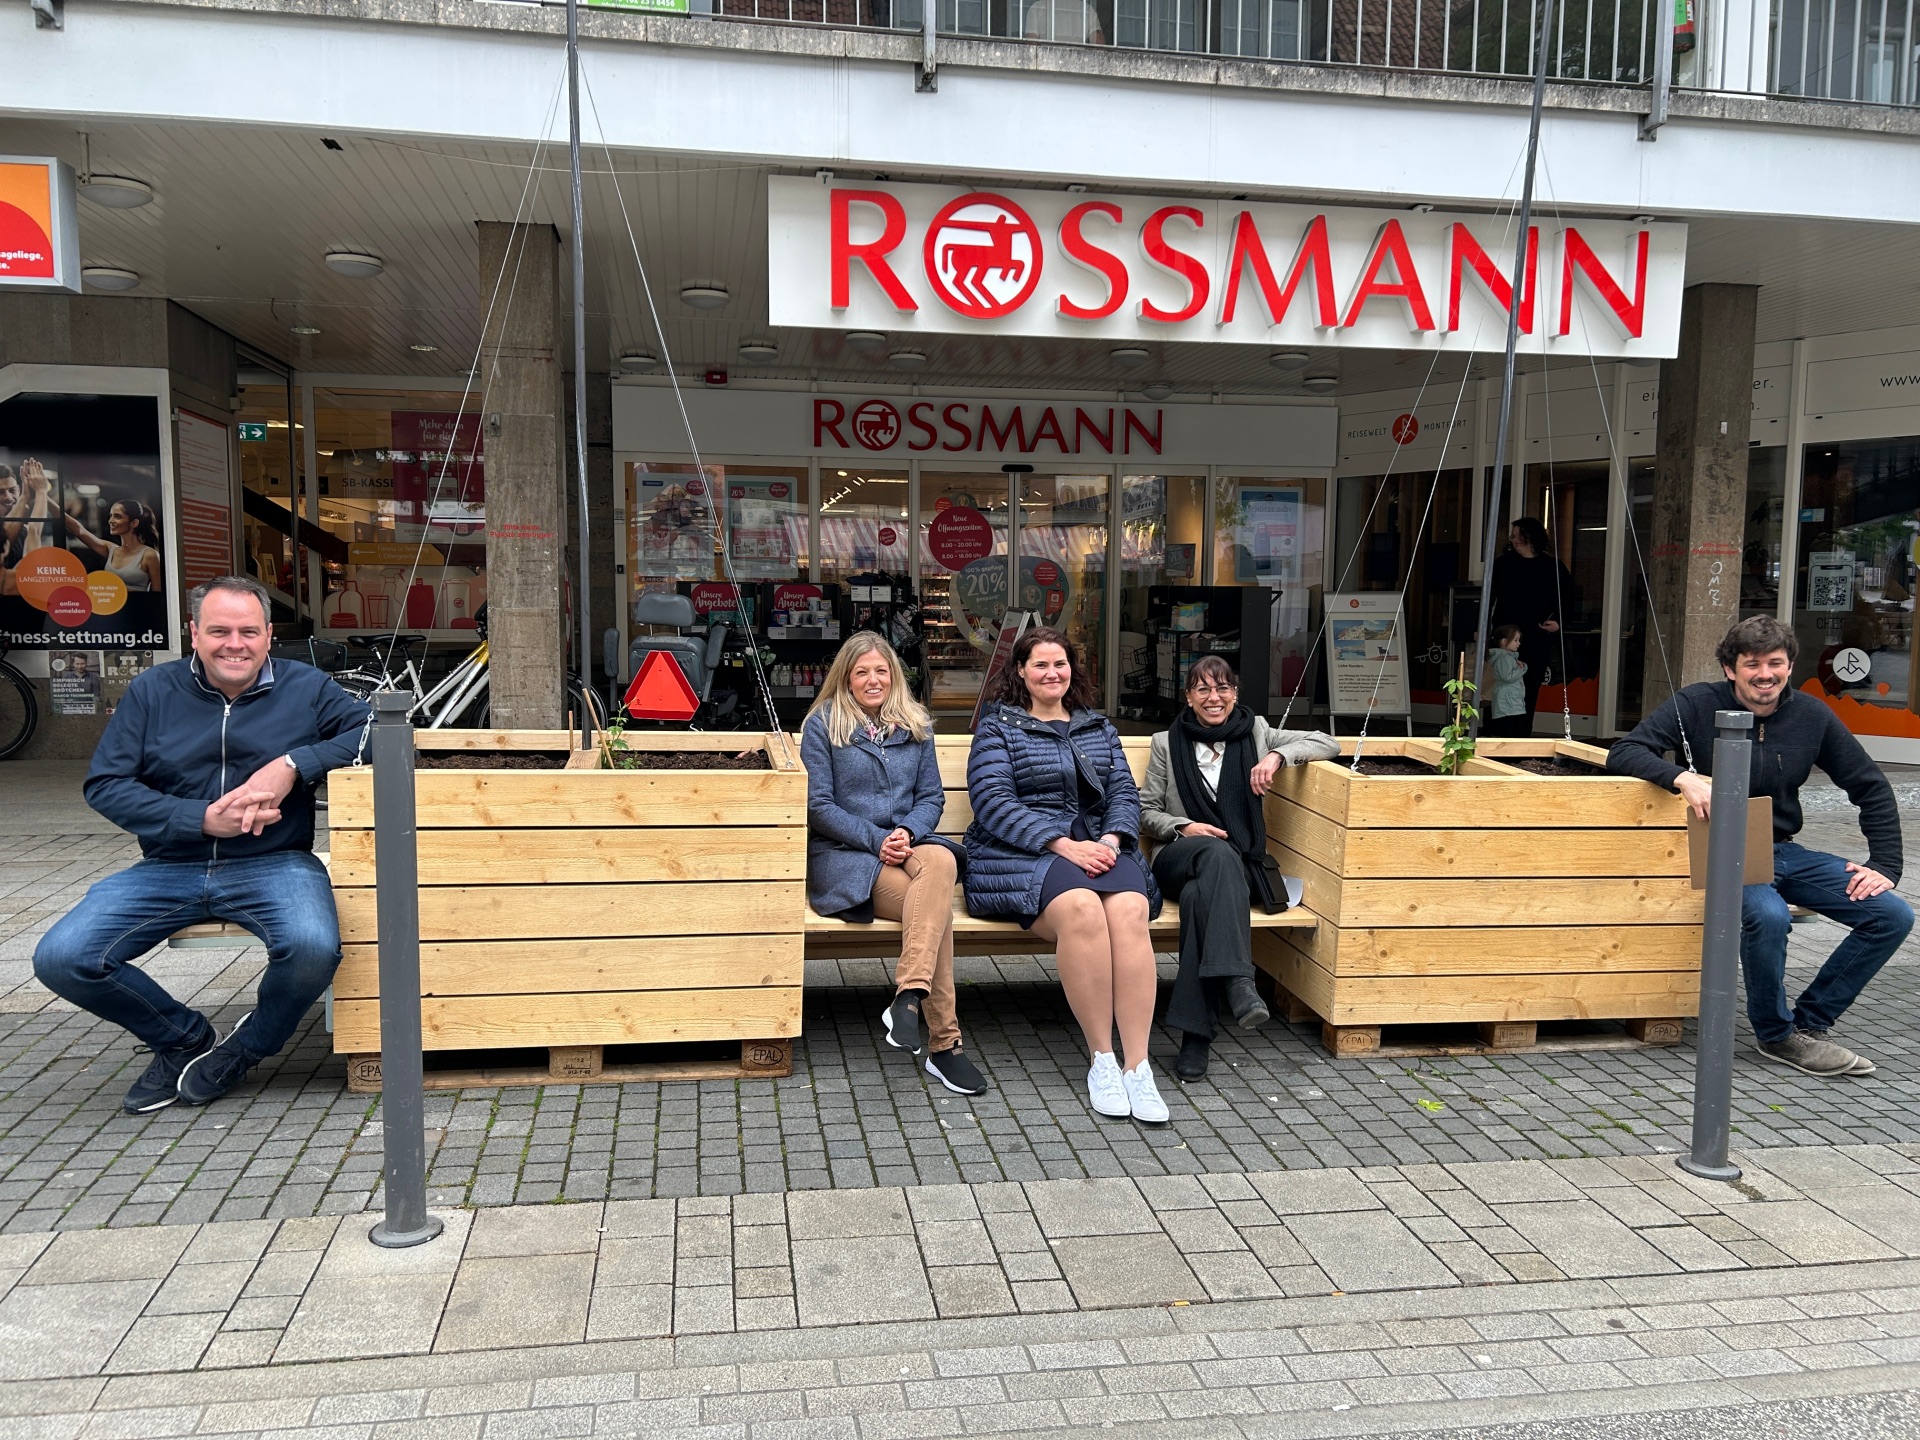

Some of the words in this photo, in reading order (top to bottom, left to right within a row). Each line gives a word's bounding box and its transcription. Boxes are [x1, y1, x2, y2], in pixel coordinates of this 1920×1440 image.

[829, 188, 1649, 340] ROSSMANN
[418, 418, 443, 430] Mehr
[444, 419, 464, 430] drn
[812, 398, 1164, 456] ROSSMANN
[422, 429, 437, 442] für
[1347, 427, 1388, 439] REISEWELT
[952, 514, 968, 523] Neue
[973, 541, 983, 549] Uhr
[972, 552, 983, 560] Uhr
[36, 566, 68, 575] KEINE
[966, 571, 1007, 597] 20%
[700, 591, 723, 600] Unsere
[783, 591, 805, 600] Unsere
[753, 1049, 778, 1062] EPAL
[360, 1065, 383, 1078] EPA
